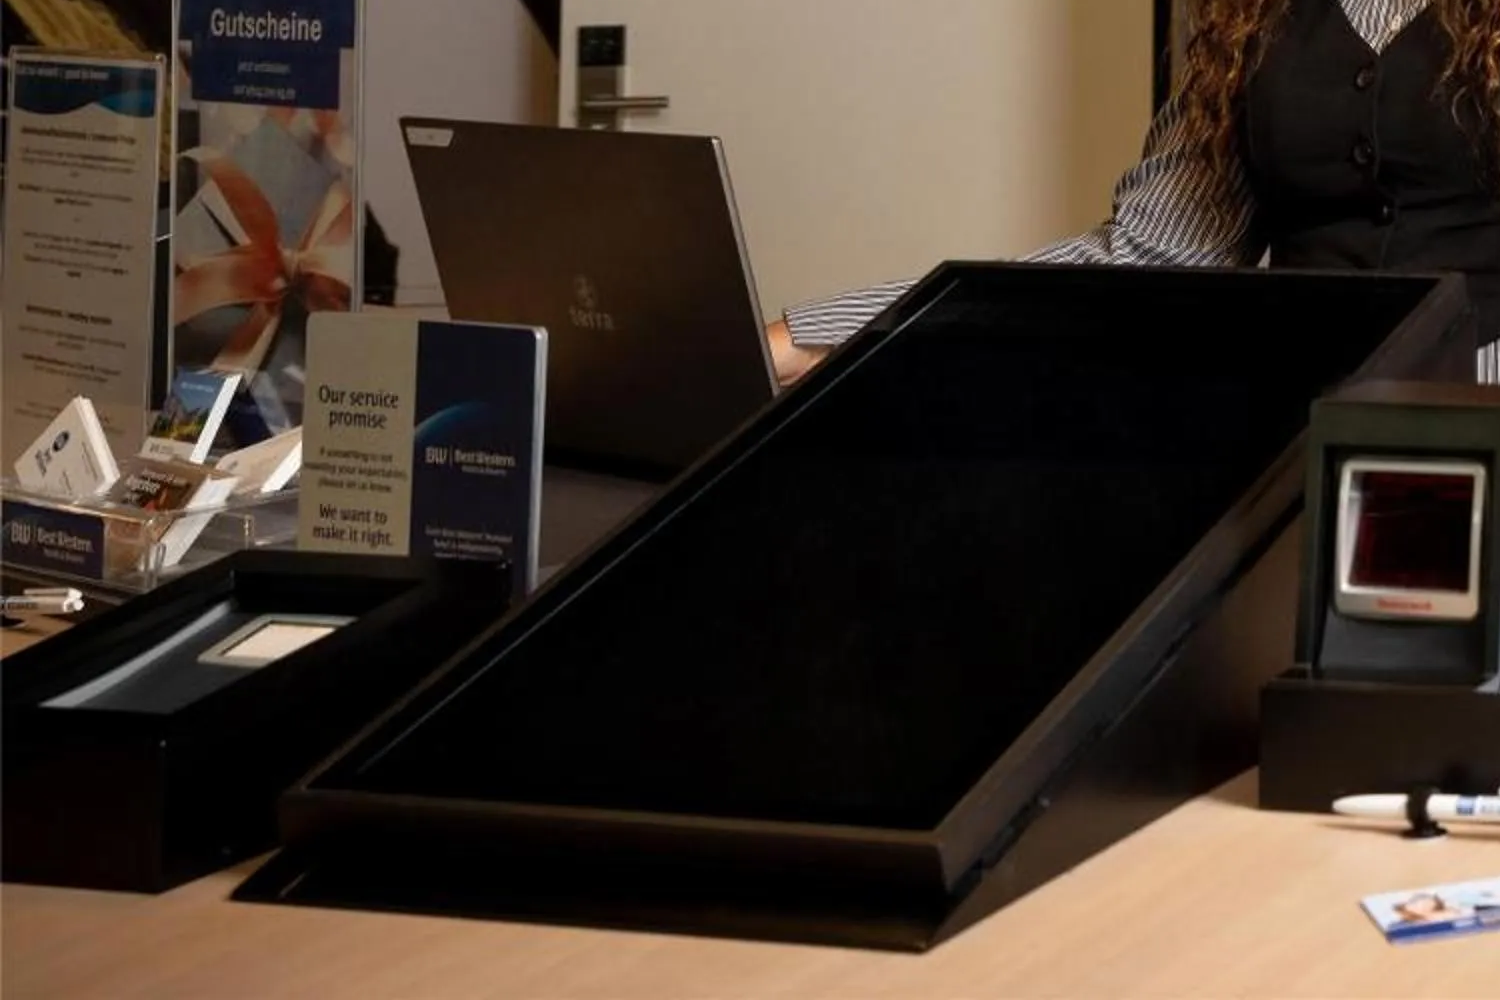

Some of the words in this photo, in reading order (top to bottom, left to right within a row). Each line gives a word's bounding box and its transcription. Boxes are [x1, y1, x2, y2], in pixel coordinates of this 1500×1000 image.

[211, 7, 323, 42] Gutscheine
[319, 384, 346, 406] Our
[350, 389, 399, 409] service
[329, 410, 387, 430] promise
[319, 503, 337, 519] We
[340, 508, 371, 524] want
[374, 510, 388, 525] to
[312, 525, 345, 542] make
[348, 526, 358, 544] it
[361, 530, 394, 549] right.
